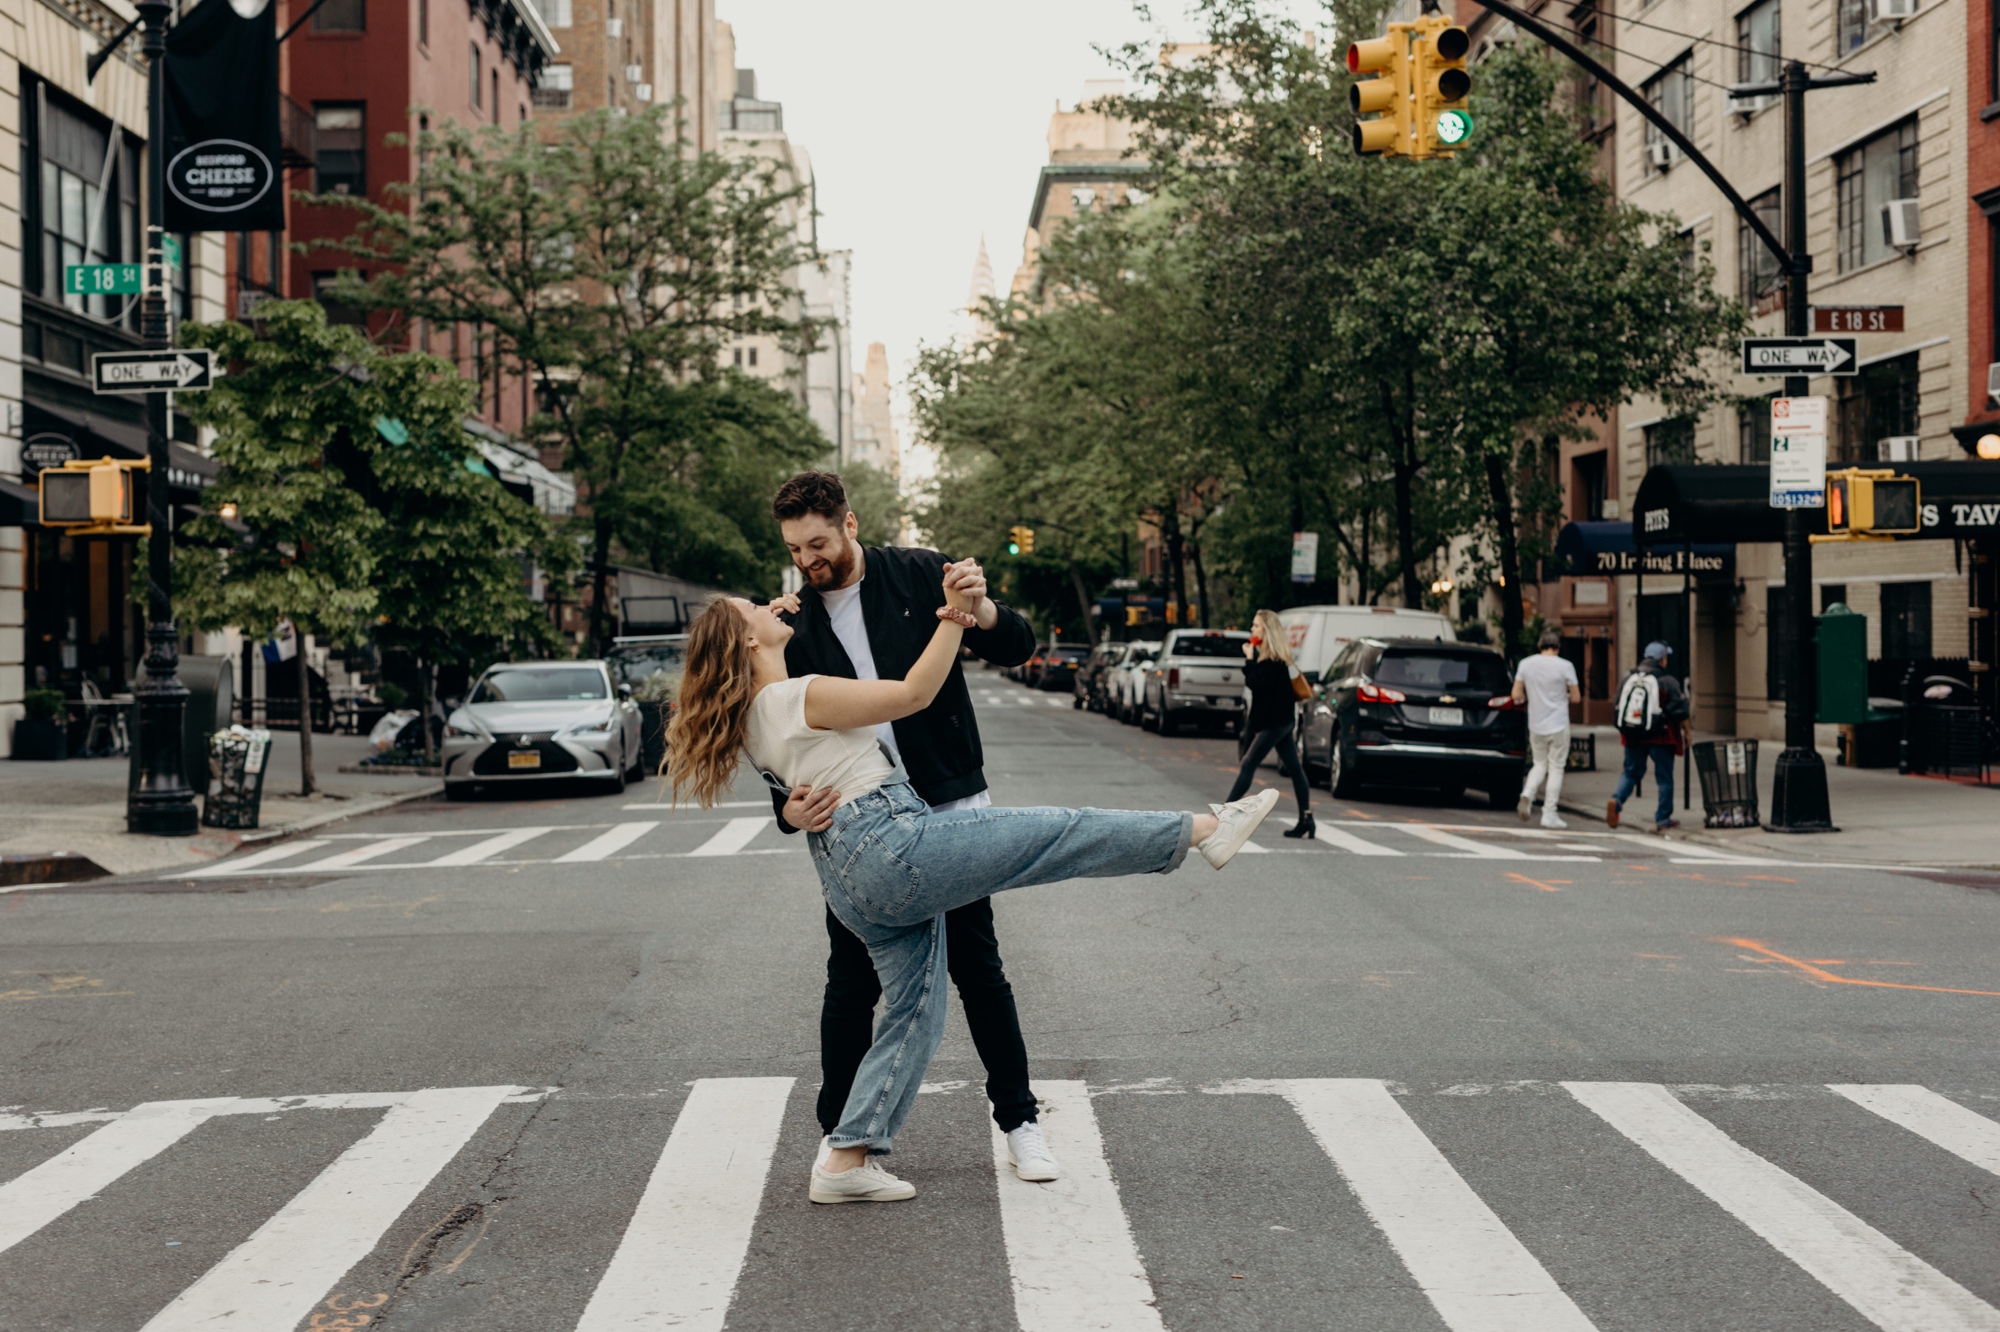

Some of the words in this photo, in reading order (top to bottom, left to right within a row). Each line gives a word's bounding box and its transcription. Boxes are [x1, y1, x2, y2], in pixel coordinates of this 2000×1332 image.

[185, 167, 256, 185] CHEESE
[75, 268, 84, 290] E
[93, 268, 115, 290] 18
[1831, 311, 1840, 330] E
[1845, 311, 1863, 330] 18
[1869, 311, 1886, 330] St
[1760, 350, 1792, 363] ONE
[1807, 350, 1840, 363] WAY
[111, 364, 144, 380] ONE
[159, 362, 192, 378] WAY
[1775, 436, 1787, 452] 2
[1951, 504, 2000, 526] TAV
[1597, 551, 1617, 570] 70
